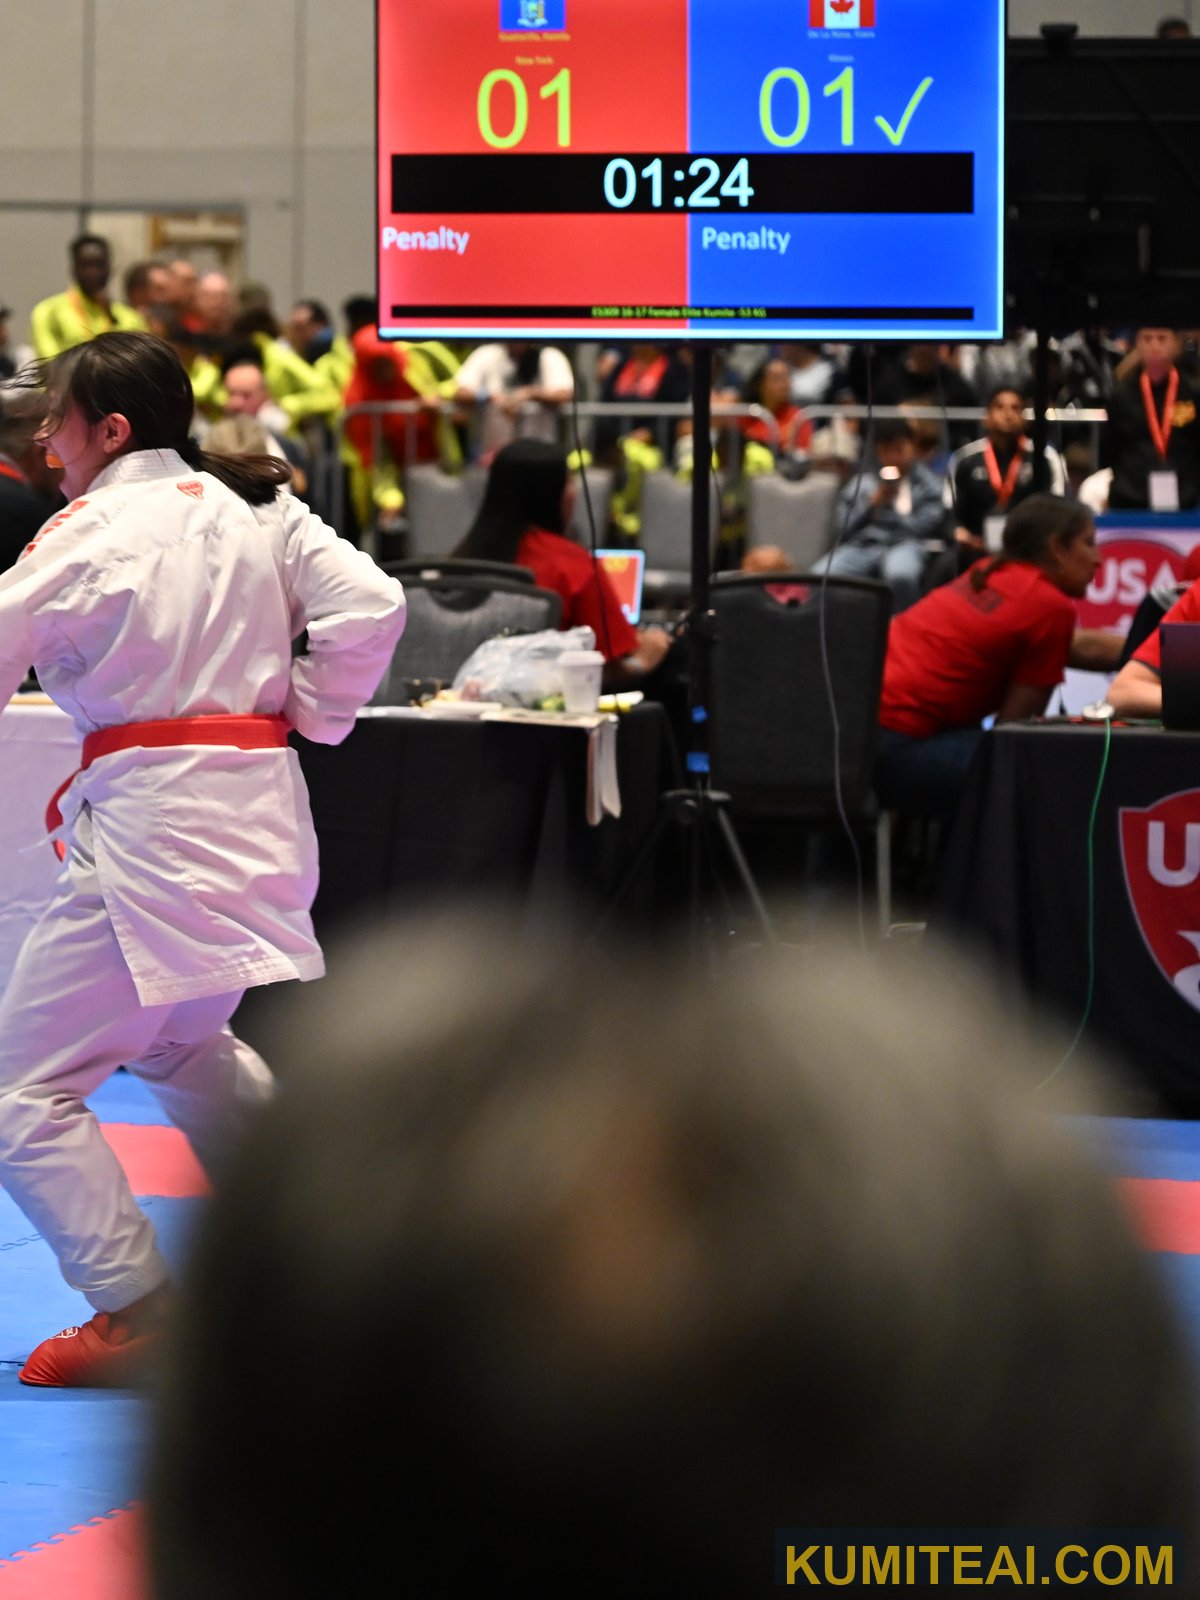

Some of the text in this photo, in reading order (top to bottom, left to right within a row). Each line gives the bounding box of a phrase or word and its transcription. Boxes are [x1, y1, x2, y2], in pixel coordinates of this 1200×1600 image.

[477, 67, 571, 149] 01
[759, 66, 854, 148] 01
[603, 158, 754, 208] 01:24
[383, 225, 470, 255] Penalty
[702, 225, 792, 255] Penalty
